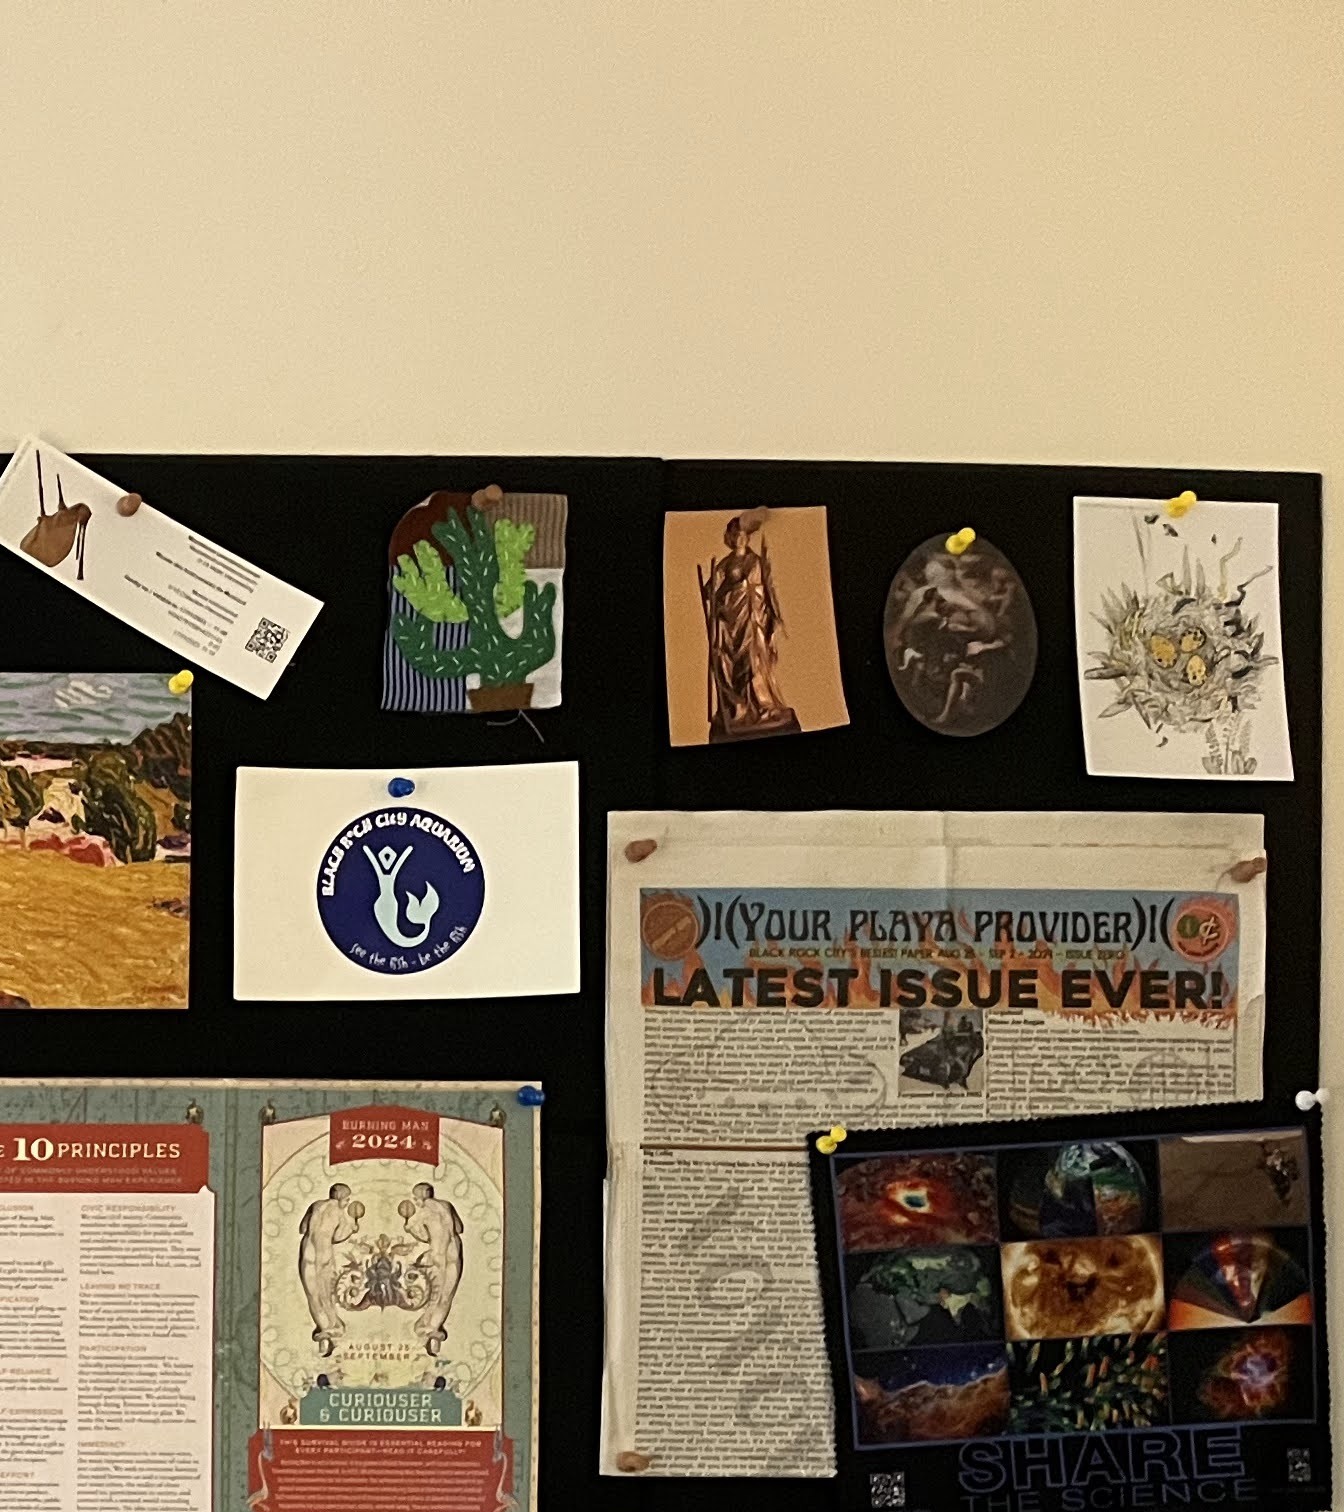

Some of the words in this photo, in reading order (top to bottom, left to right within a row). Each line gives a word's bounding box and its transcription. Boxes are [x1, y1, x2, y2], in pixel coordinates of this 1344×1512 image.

[848, 908, 954, 942] PLAYA
[653, 969, 857, 1009] LATEST
[880, 969, 1038, 1009] ISSUE
[1061, 970, 1223, 1010] EVER!
[343, 1120, 397, 1131] BURNING
[402, 1120, 429, 1131] MAN
[12, 1137, 53, 1161] 10
[58, 1144, 180, 1159] PRINCIPLES
[353, 1133, 413, 1149] 2024
[329, 1393, 432, 1408] CURIOUSER
[334, 1409, 442, 1423] CURIOUSER
[958, 1430, 1246, 1493] SHARE
[1062, 1479, 1258, 1511] SCIENCE
